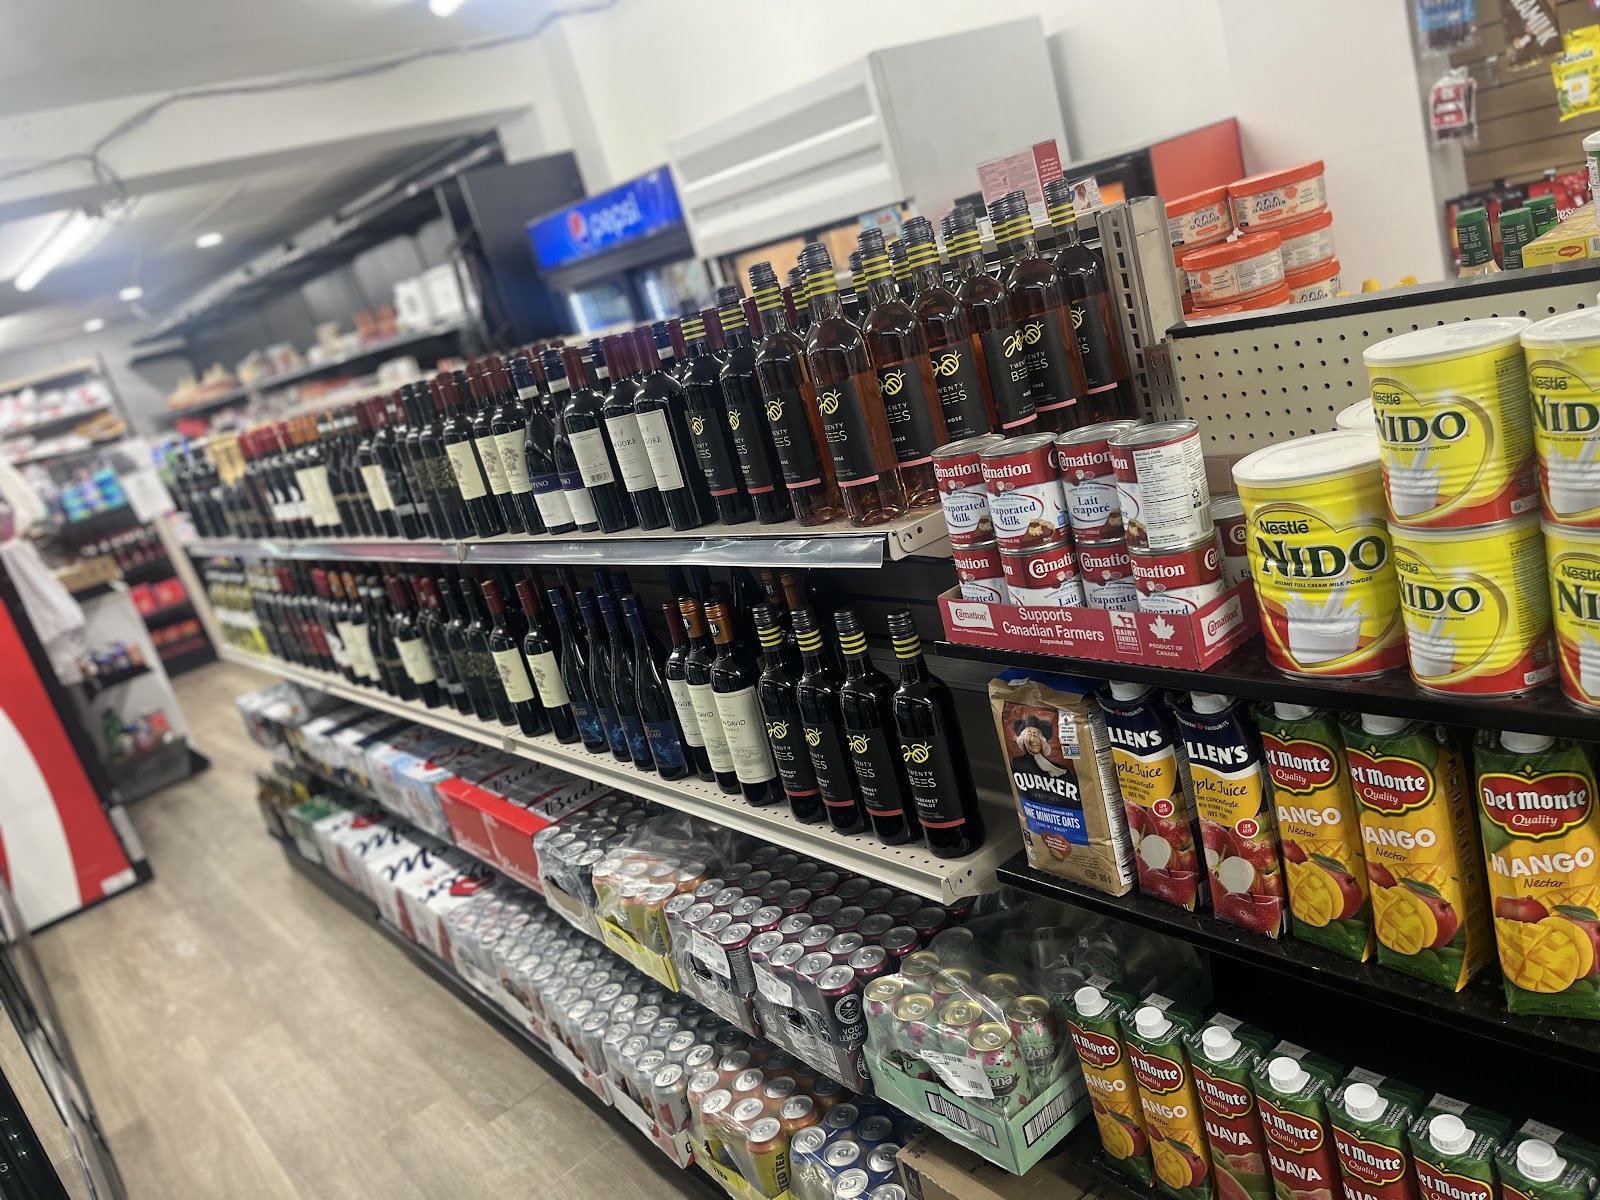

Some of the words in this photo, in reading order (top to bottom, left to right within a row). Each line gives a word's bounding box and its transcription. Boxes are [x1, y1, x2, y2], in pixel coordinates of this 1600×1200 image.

[589, 191, 642, 246] pepsi
[938, 381, 965, 395] WENTY
[941, 389, 968, 406] EES
[1530, 393, 1600, 435] NID
[1374, 408, 1470, 445] NIDO
[1077, 496, 1099, 506] Lait
[1000, 515, 1021, 526] Milk
[1260, 519, 1310, 535] Nestlé
[1029, 552, 1078, 579] Carnatio
[1080, 551, 1131, 573] Carnatio
[1255, 535, 1388, 580] NIDO
[1274, 579, 1293, 587] INSTANT
[1345, 576, 1373, 586] POWDER
[1058, 594, 1078, 607] Lait
[1089, 594, 1138, 608] Evaporate
[1555, 578, 1600, 623] NI
[955, 608, 986, 622] Carnation
[1018, 607, 1073, 624] Supports
[1207, 604, 1239, 636] Carnation
[1002, 621, 1054, 638] Canadian
[1055, 624, 1105, 642] Farmers
[1115, 628, 1136, 637] DAIRY
[1117, 635, 1138, 643] FARMERS
[1148, 643, 1176, 651] PRODUCT
[1204, 720, 1230, 731] FAVOURITE
[1107, 726, 1163, 749] LLEN'S
[1184, 740, 1249, 765] LLEN'S
[1265, 749, 1277, 764] el
[1278, 751, 1331, 774] Monte
[907, 768, 933, 777] TWENTY
[1114, 761, 1135, 776] ple
[1136, 764, 1163, 779] Juice
[1275, 768, 1307, 786] Quality
[1351, 765, 1365, 784] el
[1367, 768, 1426, 793] Monte
[909, 775, 937, 788] BEES
[1013, 771, 1078, 802] QUAKER
[1126, 778, 1155, 789] concentrate
[1218, 780, 1248, 796] Juice
[914, 796, 938, 804] CABERNET
[1206, 796, 1239, 808] concentrate
[1363, 786, 1399, 805] Quality
[1483, 787, 1515, 812] Del
[1515, 788, 1587, 813] Monte
[1024, 806, 1036, 819] ONE
[1036, 811, 1063, 826] MINUTE
[1062, 816, 1081, 829] OATS
[1276, 806, 1341, 827] ANGO
[1511, 814, 1558, 827] Quality
[1287, 824, 1316, 839] Nectar
[1375, 845, 1408, 863] Nectar
[1491, 846, 1595, 878] MANGO
[1523, 876, 1566, 890] Nectar
[842, 1023, 864, 1035] VODK
[1072, 1032, 1080, 1047] el
[1081, 1036, 1116, 1056] Monte
[1079, 1046, 1101, 1063] Quality
[1130, 1054, 1140, 1072] el
[1140, 1060, 1178, 1081] Monte
[1084, 1072, 1126, 1092] ANGO
[1138, 1070, 1161, 1088] Quality
[1092, 1086, 1111, 1100] Nectar
[1195, 1077, 1205, 1093] el
[1206, 1084, 1248, 1106] Monte
[1142, 1096, 1188, 1119] ANGO
[1204, 1095, 1229, 1113] Quality
[1148, 1112, 1170, 1127] Nectar
[1261, 1110, 1273, 1126] el
[1273, 1117, 1319, 1141] Monte
[1271, 1127, 1299, 1147] Quality
[775, 1151, 785, 1173] TEA
[1352, 1145, 1401, 1171] Monte
[1348, 1158, 1379, 1180] Quality
[1434, 1177, 1487, 1200] Monte
